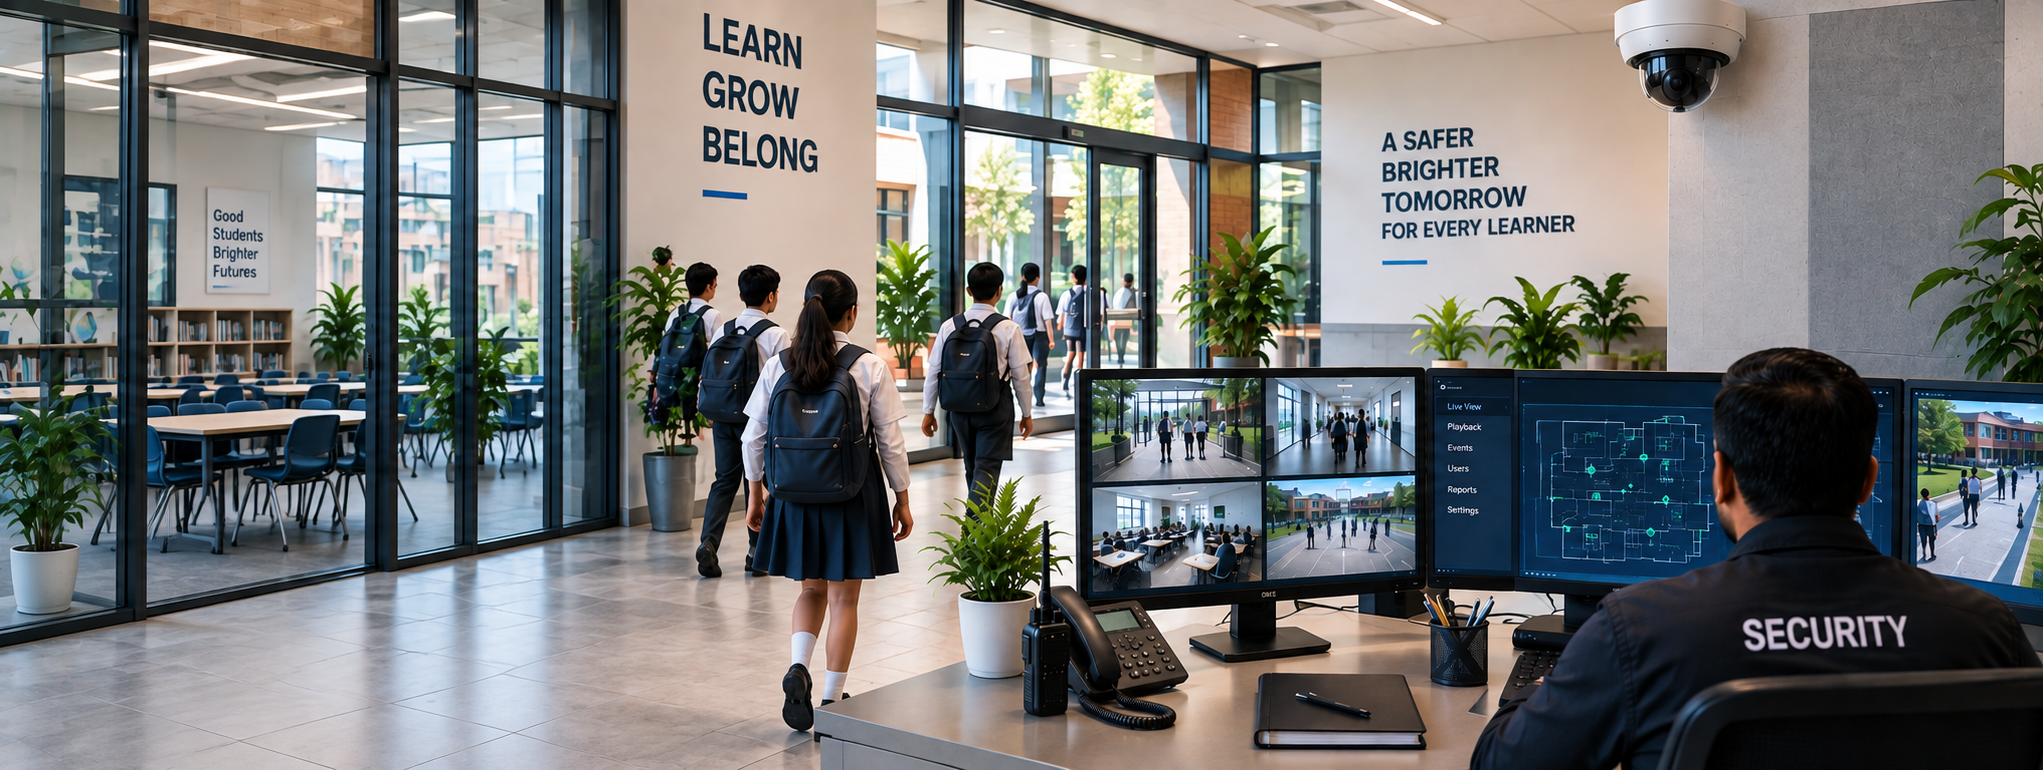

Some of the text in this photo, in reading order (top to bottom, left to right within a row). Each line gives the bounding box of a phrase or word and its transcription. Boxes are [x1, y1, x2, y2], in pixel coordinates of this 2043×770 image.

[703, 12, 802, 70] LEARN
[702, 70, 800, 120] GROW
[1381, 127, 1474, 152] A SAFER
[703, 125, 818, 173] BELONG
[1382, 156, 1499, 182] BRIGHTER
[1381, 185, 1528, 213] TOMORROW
[213, 208, 244, 223] Good
[213, 226, 264, 243] Students
[1381, 215, 1576, 240] FOR EVERY LEARNER
[213, 245, 259, 263] Brighter
[213, 264, 257, 278] Futures
[1447, 402, 1482, 411] Live View
[1447, 422, 1482, 433] Playback
[1447, 443, 1474, 452] Events
[1447, 464, 1470, 473] Users
[1447, 485, 1478, 495] Reports
[1447, 505, 1480, 517] Settings
[1742, 615, 1907, 652] SECURITY
